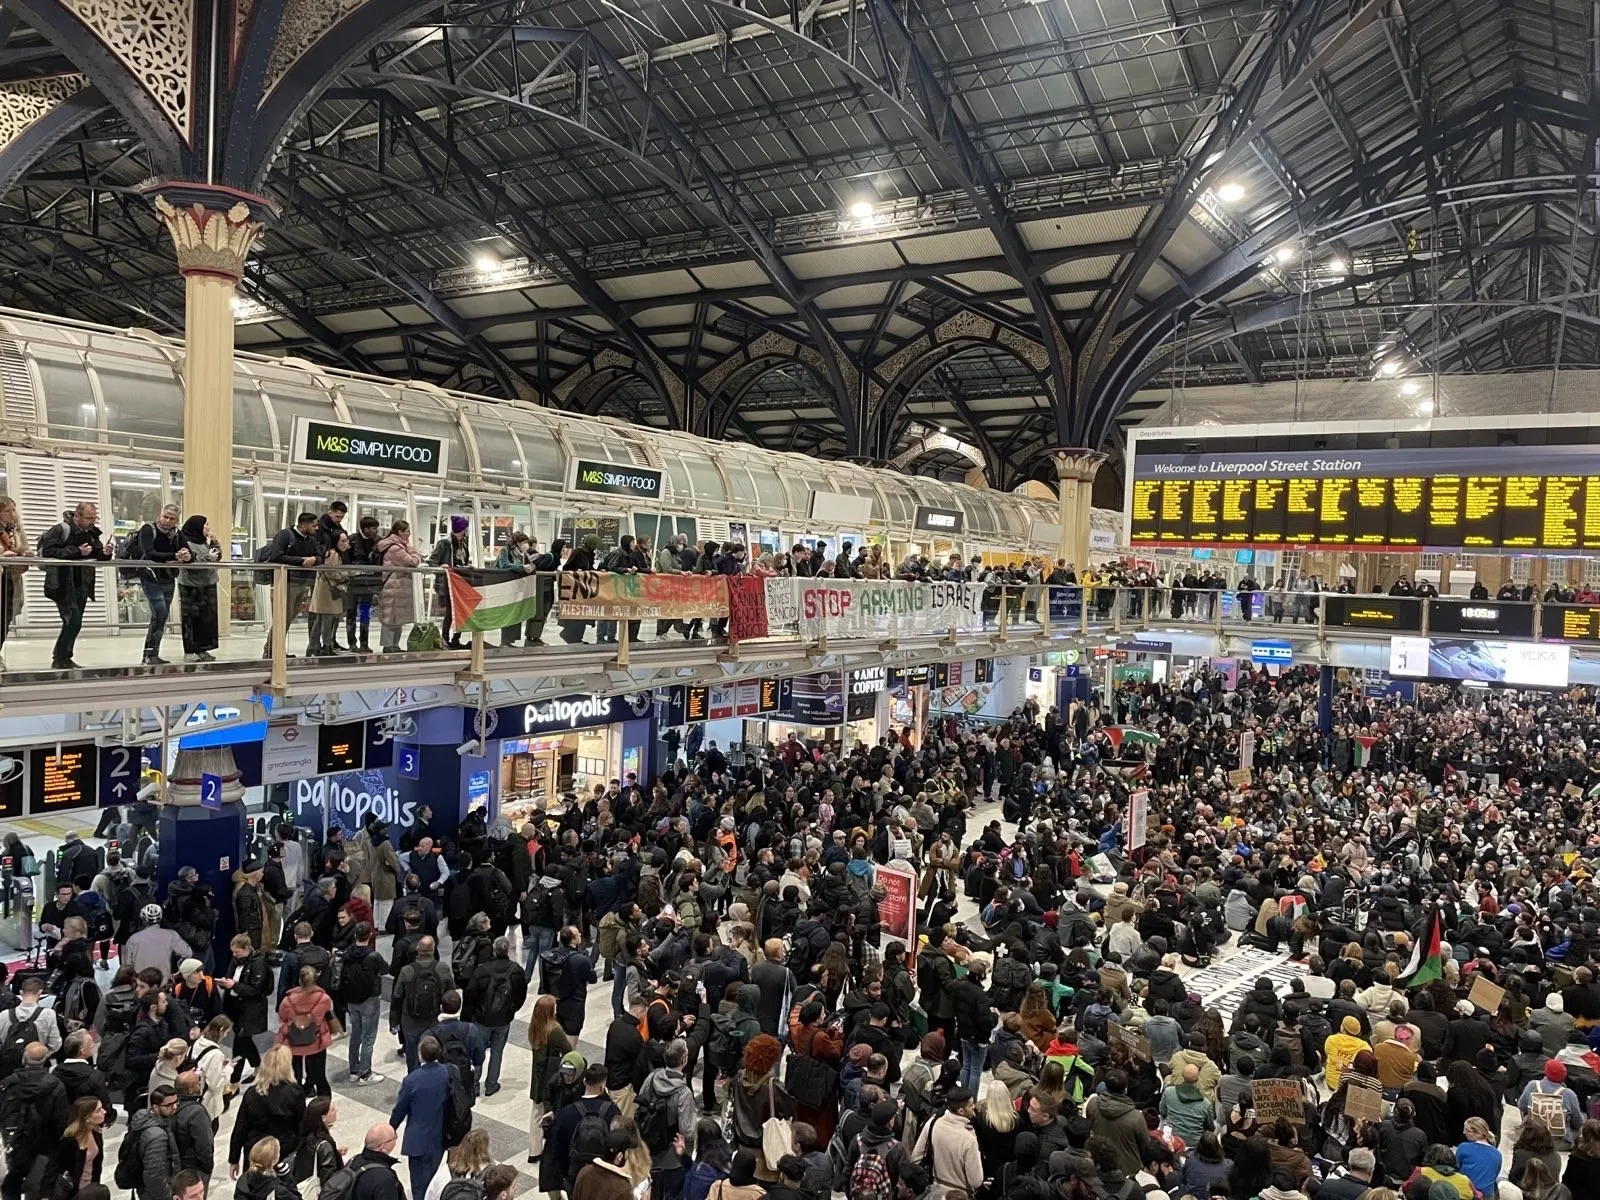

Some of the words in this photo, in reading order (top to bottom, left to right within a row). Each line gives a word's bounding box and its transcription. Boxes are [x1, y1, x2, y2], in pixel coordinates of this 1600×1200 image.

[317, 435, 349, 453] M&S
[350, 439, 394, 458] SIMPLY
[394, 445, 432, 463] FOOD
[1154, 463, 1196, 474] Welcome
[1197, 464, 1208, 473] to
[1210, 460, 1267, 475] Liverpool
[1269, 459, 1309, 472] Street
[1311, 459, 1362, 471] Station
[582, 470, 604, 484] M&S
[603, 473, 632, 487] SIMPLY
[631, 476, 656, 490] FOOD
[558, 571, 599, 601] END
[804, 589, 852, 619] STOP
[859, 586, 924, 617] ARMING
[931, 584, 977, 615] ISRAEL
[560, 604, 605, 617] ALESTINIAN
[860, 667, 880, 680] AMT
[1032, 672, 1039, 680] 6
[1069, 667, 1075, 675] 7
[1125, 670, 1146, 678] TASTY
[782, 680, 790, 696] 5
[853, 679, 884, 694] COFFEE
[672, 689, 682, 708] 4
[373, 721, 388, 745] 3
[110, 748, 131, 777] 2
[405, 754, 413, 772] 3
[206, 780, 215, 801] 2
[296, 779, 417, 829] panopolis
[877, 874, 888, 883] Do
[888, 878, 900, 886] not
[887, 885, 899, 893] use
[888, 894, 907, 904] staff!
